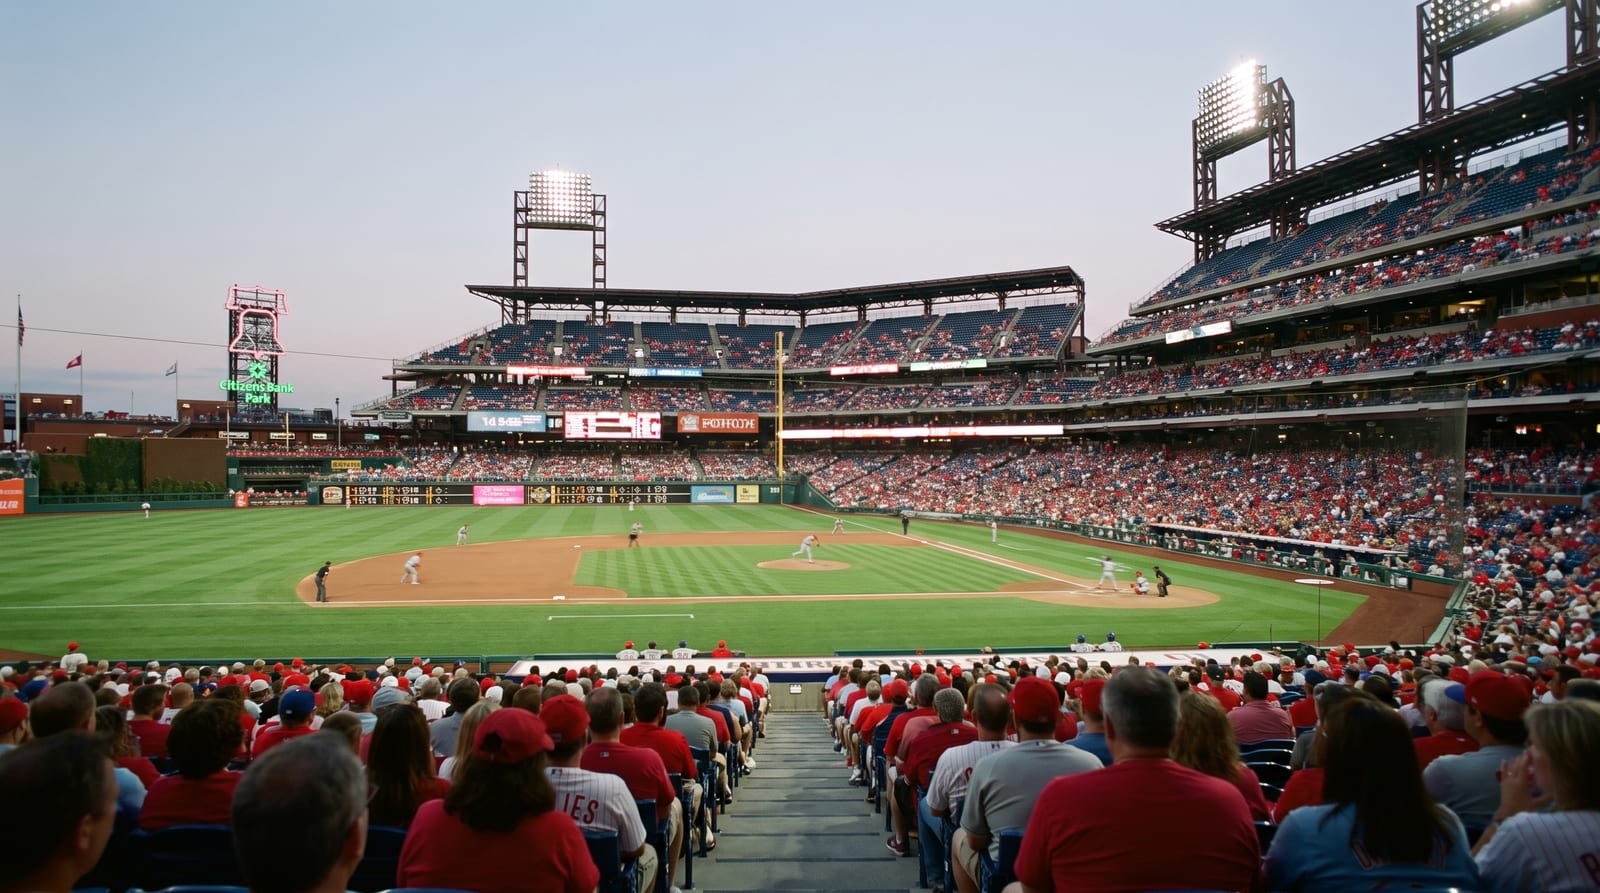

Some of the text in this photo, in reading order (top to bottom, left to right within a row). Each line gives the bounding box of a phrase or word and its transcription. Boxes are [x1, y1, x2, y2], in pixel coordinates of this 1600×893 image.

[220, 380, 294, 393] Citizens Bank
[245, 393, 271, 404] Park
